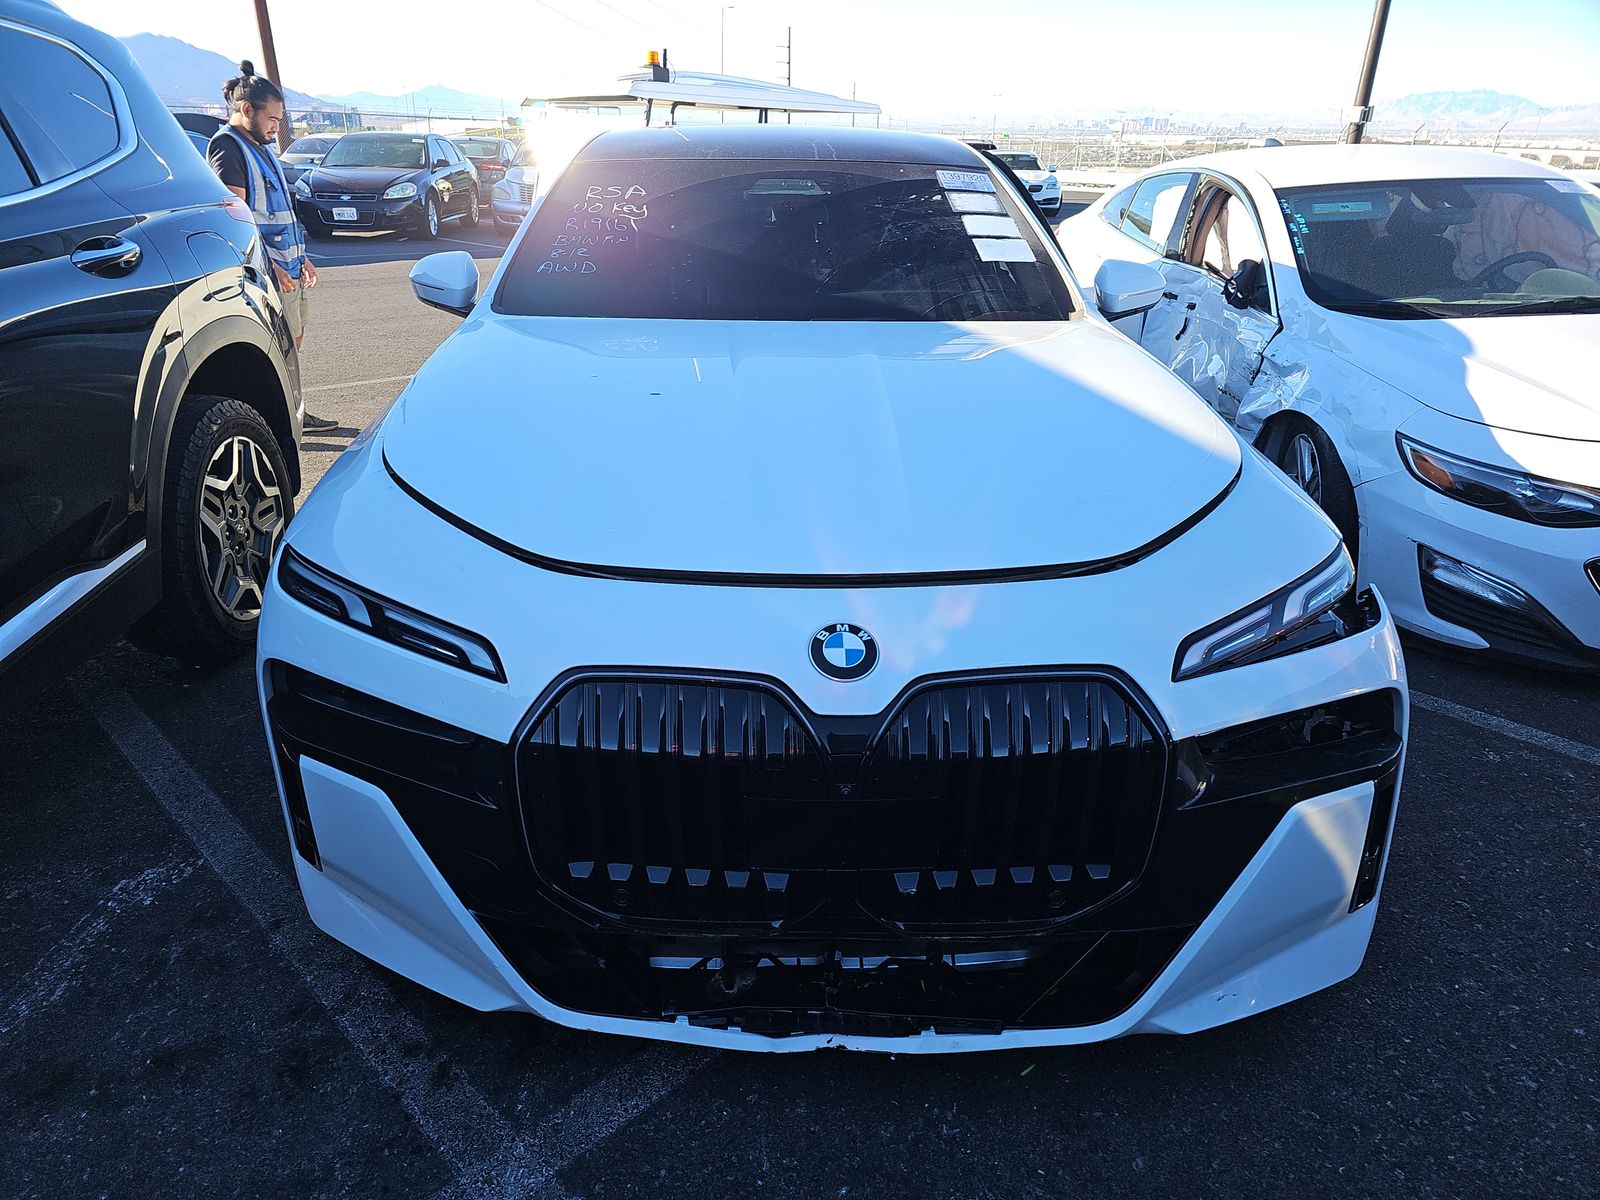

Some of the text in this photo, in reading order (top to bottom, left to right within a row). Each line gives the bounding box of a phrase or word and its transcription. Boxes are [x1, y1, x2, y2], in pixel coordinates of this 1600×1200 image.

[941, 172, 987, 183] 1397920
[586, 185, 647, 200] RSA
[569, 202, 648, 219] NO Key
[552, 235, 599, 246] BMW
[536, 261, 597, 274] AWD
[816, 624, 872, 641] BMW
